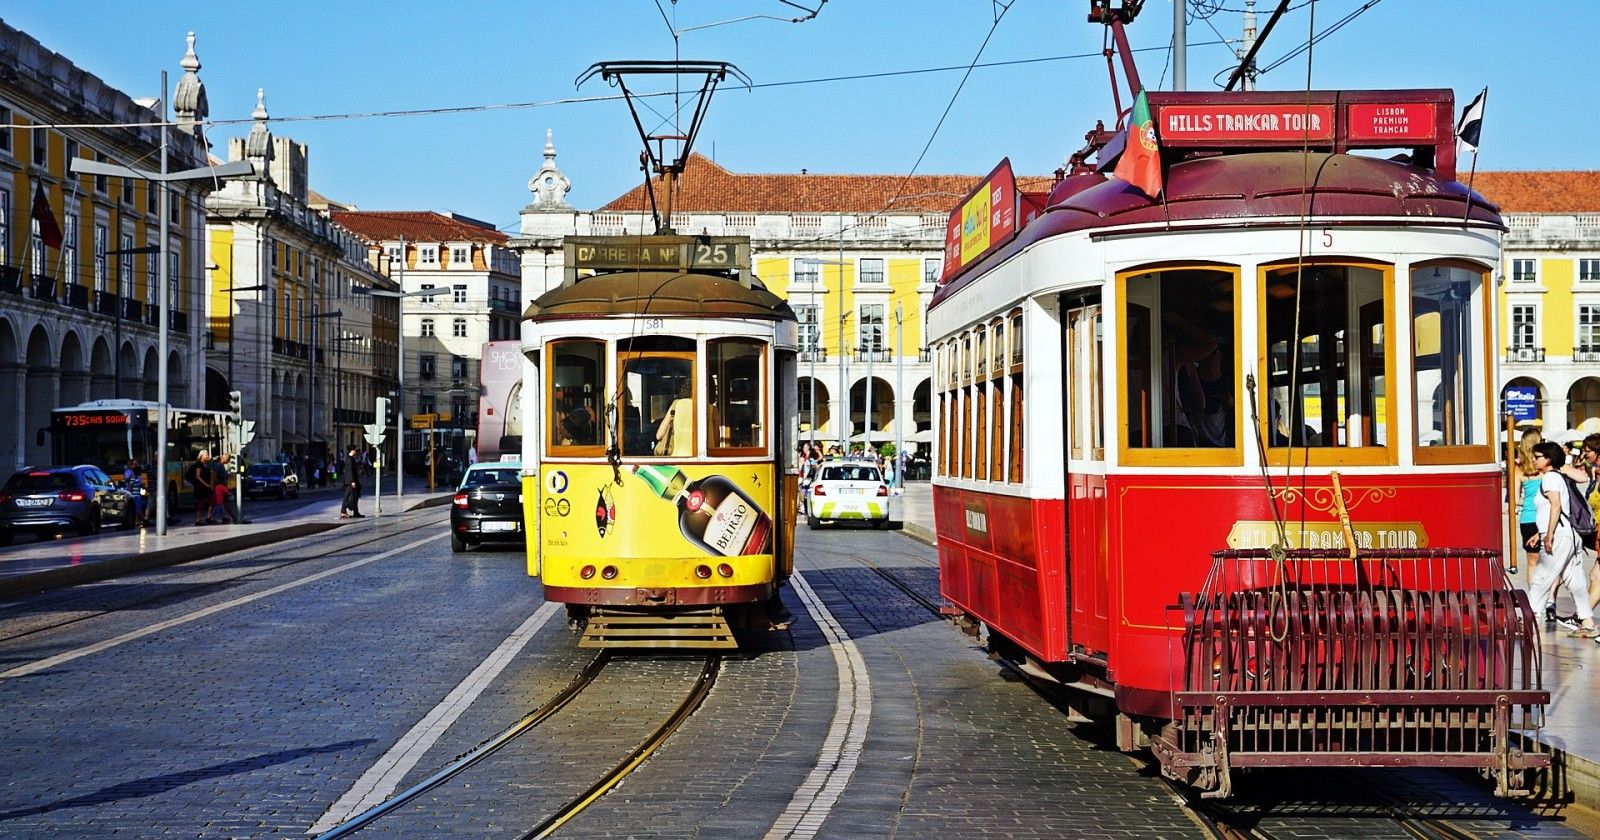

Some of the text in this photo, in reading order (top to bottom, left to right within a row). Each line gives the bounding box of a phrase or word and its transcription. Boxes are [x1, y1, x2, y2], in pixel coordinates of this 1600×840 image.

[1376, 107, 1405, 116] LISBON
[1169, 113, 1321, 132] HILLS TRAMCAR TOUR
[1373, 117, 1409, 125] PREMIUM
[1373, 126, 1409, 134] TRAMCAR
[1323, 227, 1332, 248] 5
[698, 244, 728, 264] 25
[646, 318, 664, 329] 581
[65, 415, 86, 426] 735
[716, 504, 747, 549] BEIRÃO
[1298, 530, 1373, 549] TRAMAR
[1377, 530, 1418, 549] TOUR
